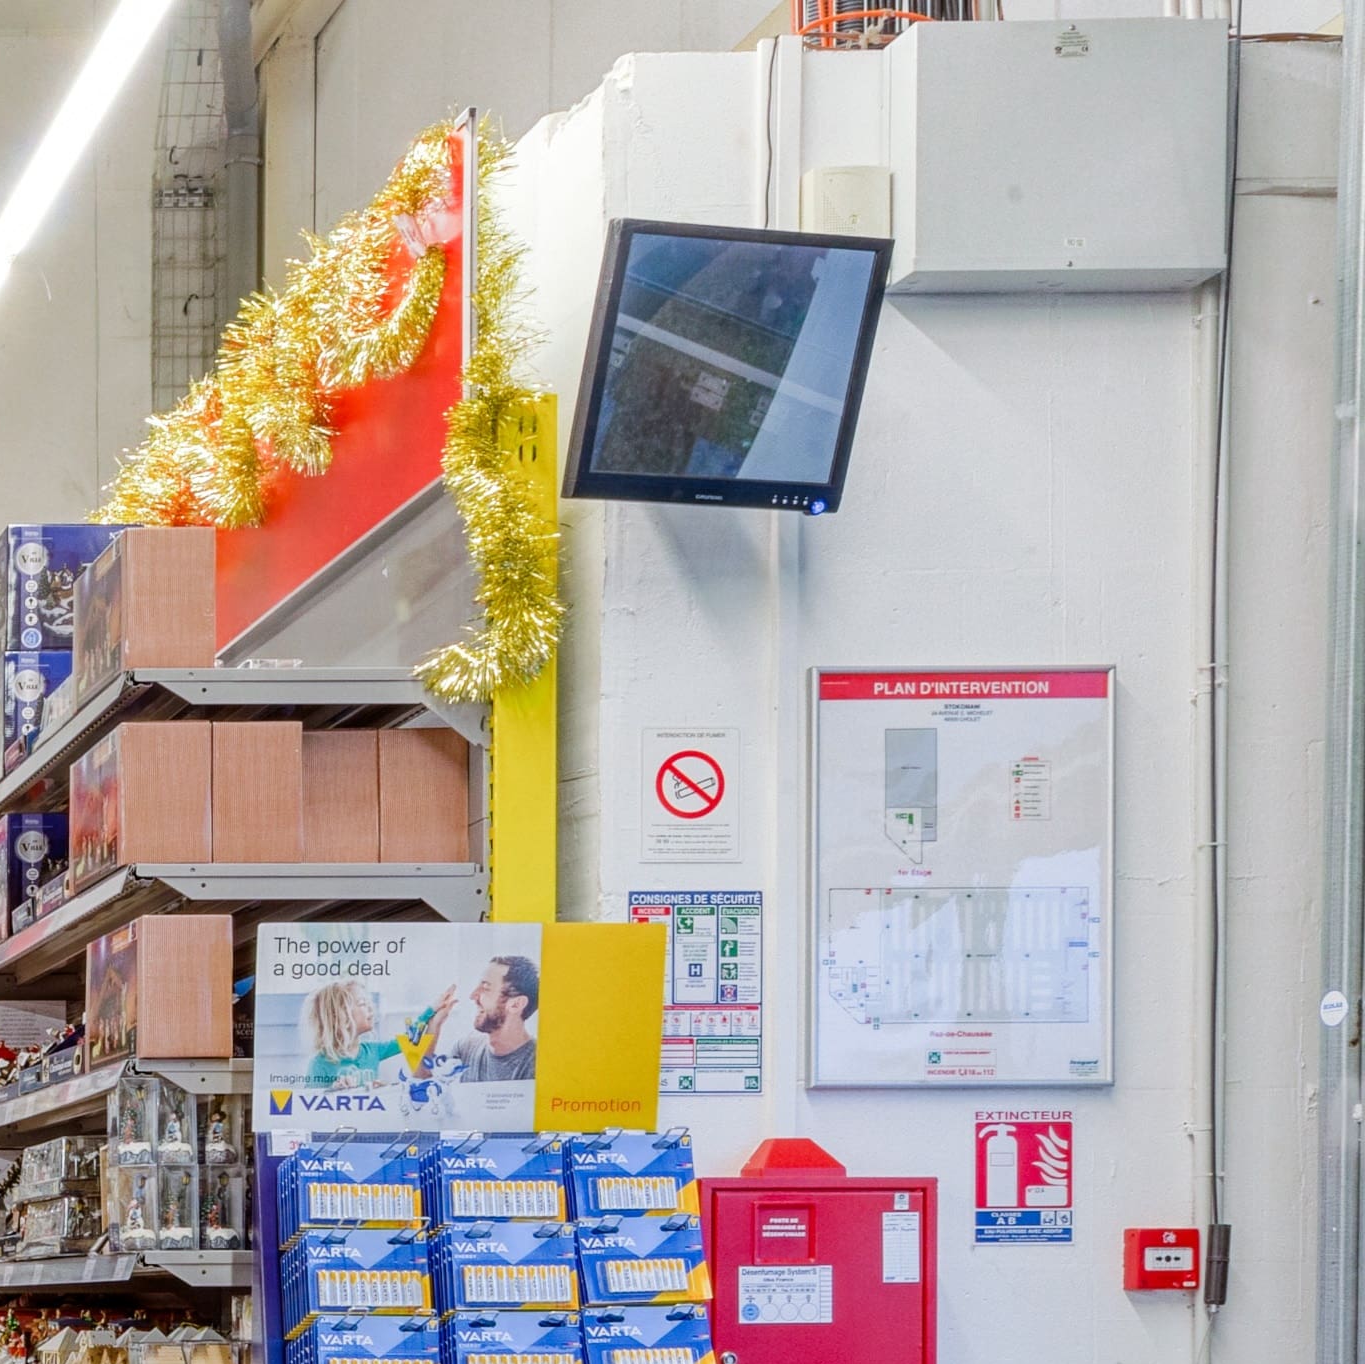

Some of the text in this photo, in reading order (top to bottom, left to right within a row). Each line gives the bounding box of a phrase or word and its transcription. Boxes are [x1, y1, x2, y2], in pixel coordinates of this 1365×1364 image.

[873, 681, 1050, 696] PLAN D'INTERVENTION
[631, 892, 761, 904] CONSIGNES DE SÉCURITÉ
[274, 937, 406, 959] The power of
[273, 960, 391, 980] a good deal
[269, 1073, 341, 1087] Imagine more
[299, 1095, 387, 1112] VARTA
[551, 1098, 642, 1113] Promotion
[975, 1111, 1073, 1120] EXTINCTEUR
[443, 1157, 497, 1168] VARTA
[574, 1153, 628, 1164] VARTA
[301, 1160, 354, 1171] VARTA
[996, 1217, 1006, 1225] A
[454, 1242, 508, 1253] VARTA
[581, 1236, 636, 1248] VARTA
[309, 1247, 362, 1258] VARTA
[459, 1331, 513, 1341] VARTA
[587, 1325, 642, 1337] VARTA
[320, 1334, 374, 1345] VARTA
